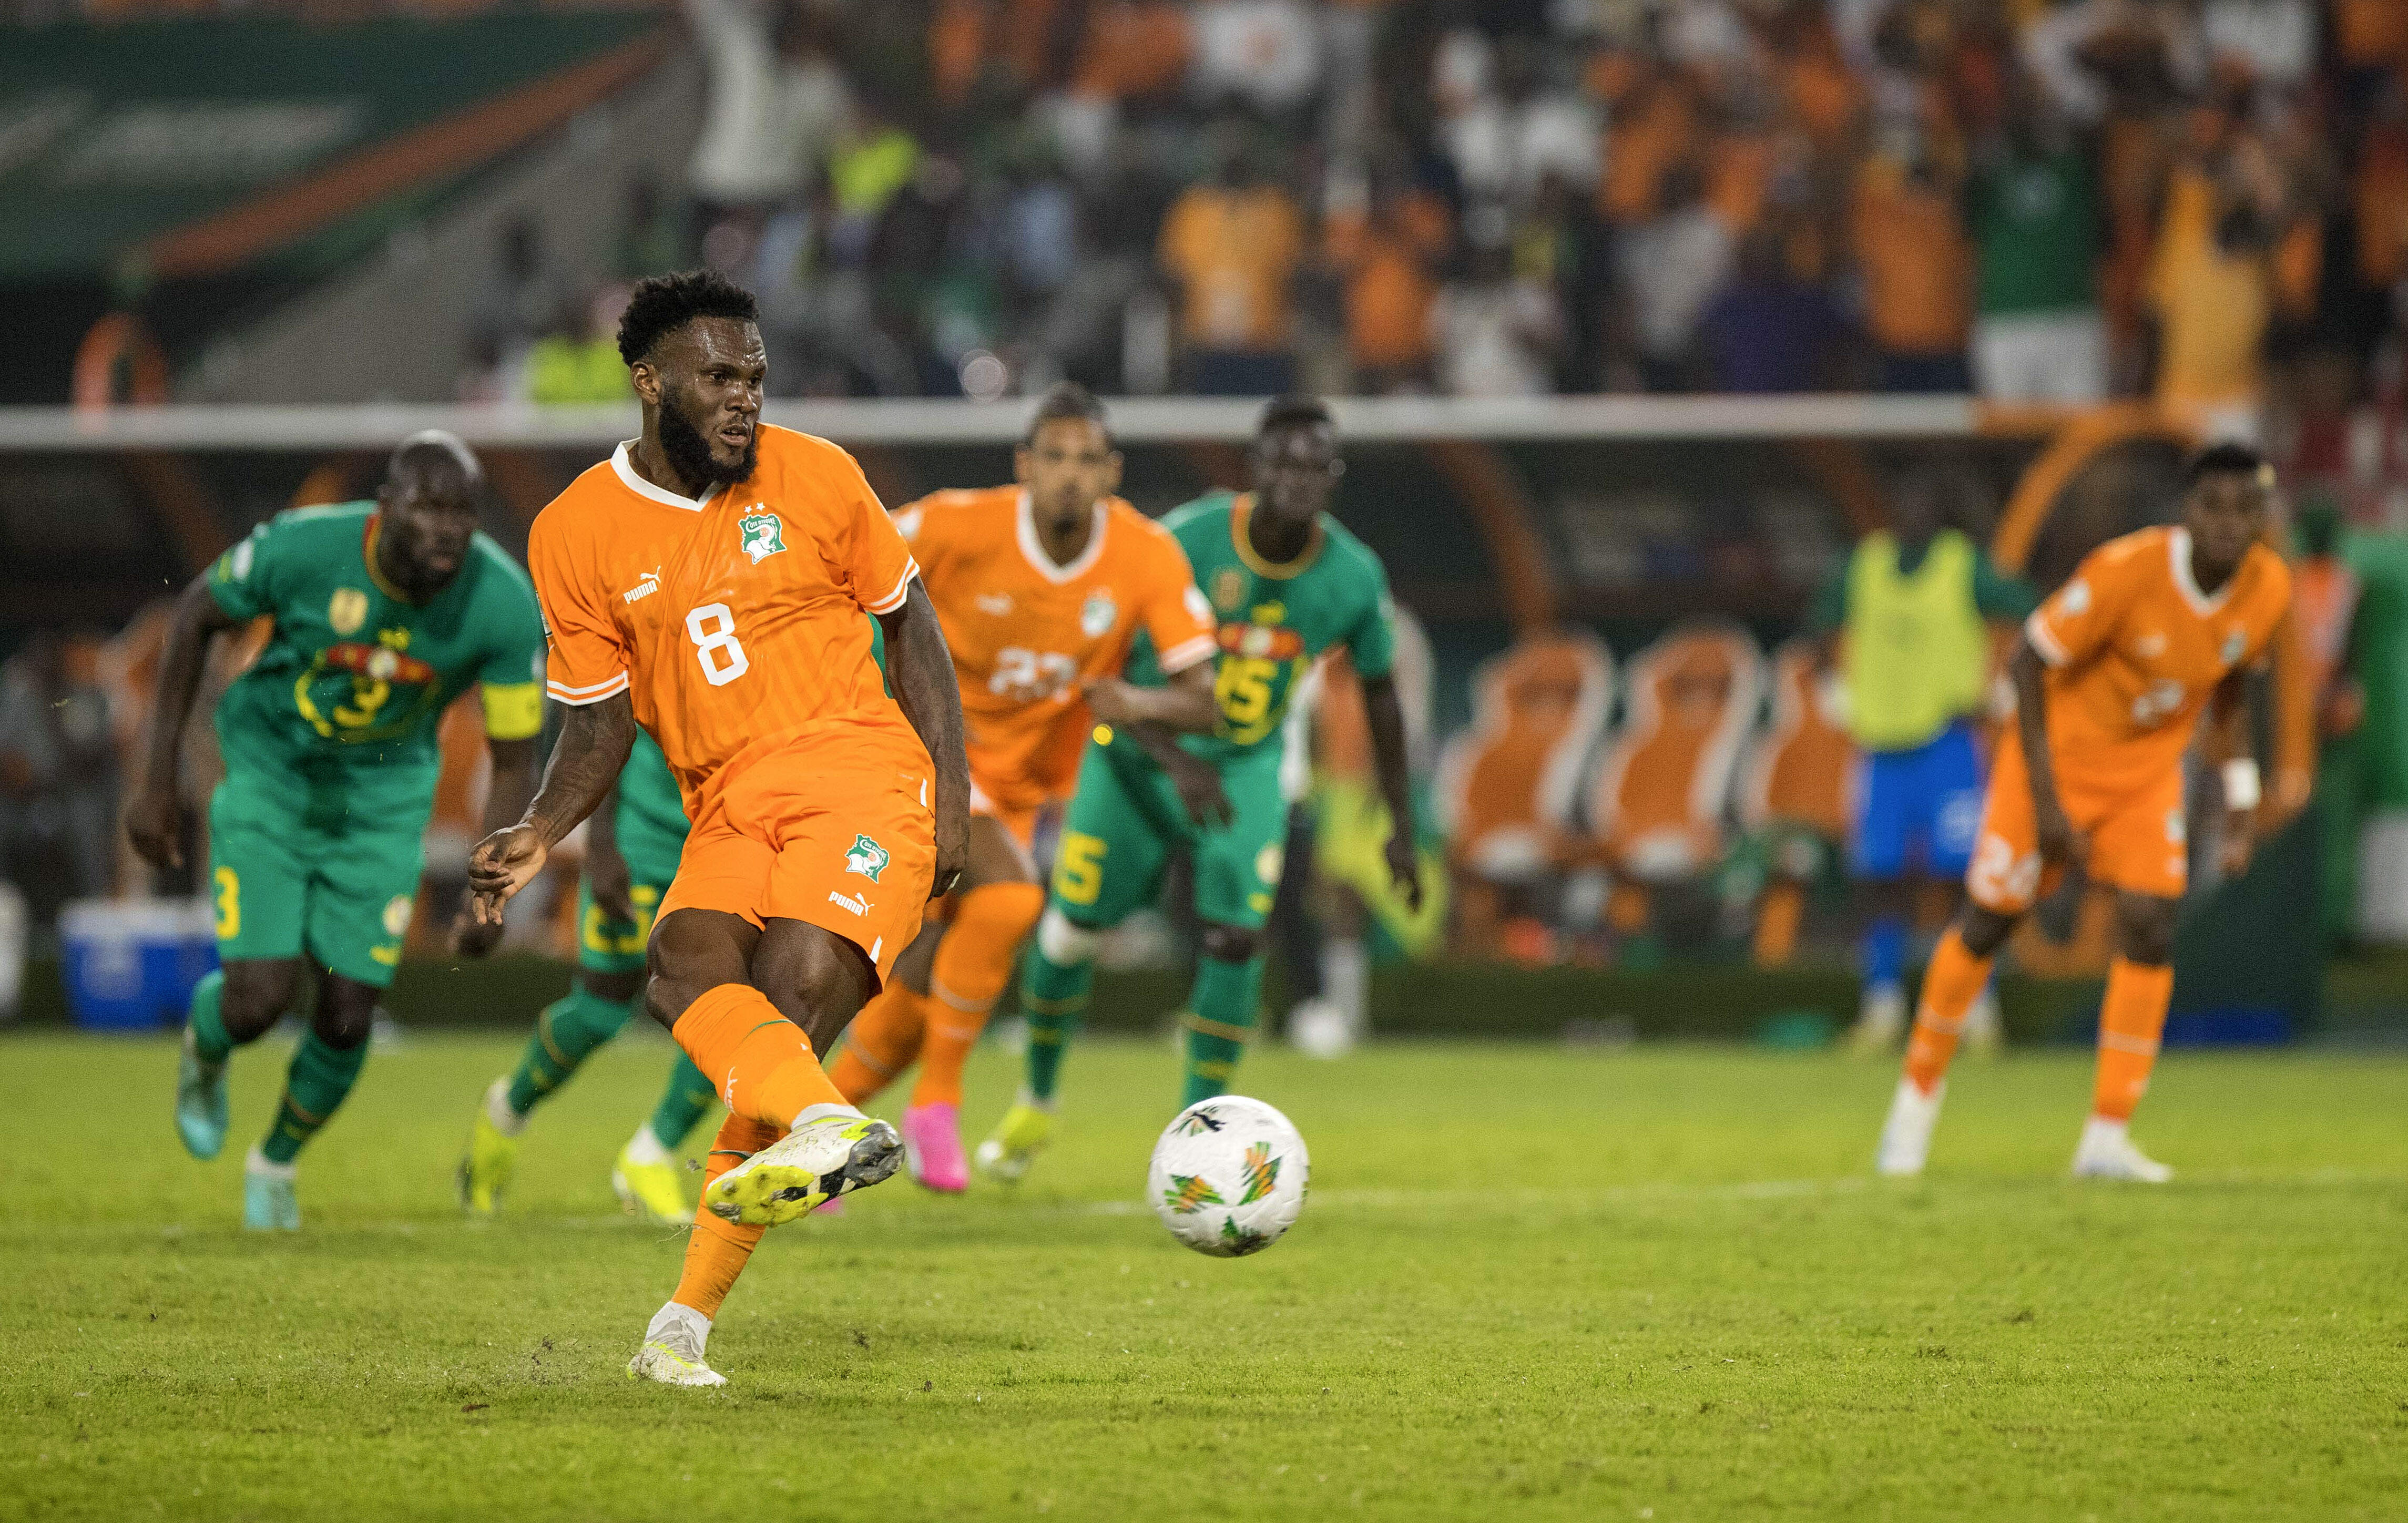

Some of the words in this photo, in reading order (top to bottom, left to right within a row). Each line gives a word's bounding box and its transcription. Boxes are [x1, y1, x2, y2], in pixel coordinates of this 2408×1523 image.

[623, 579, 658, 604] PUMA
[685, 602, 750, 686] 8
[215, 866, 241, 940] 3
[828, 891, 864, 917] PUMA
